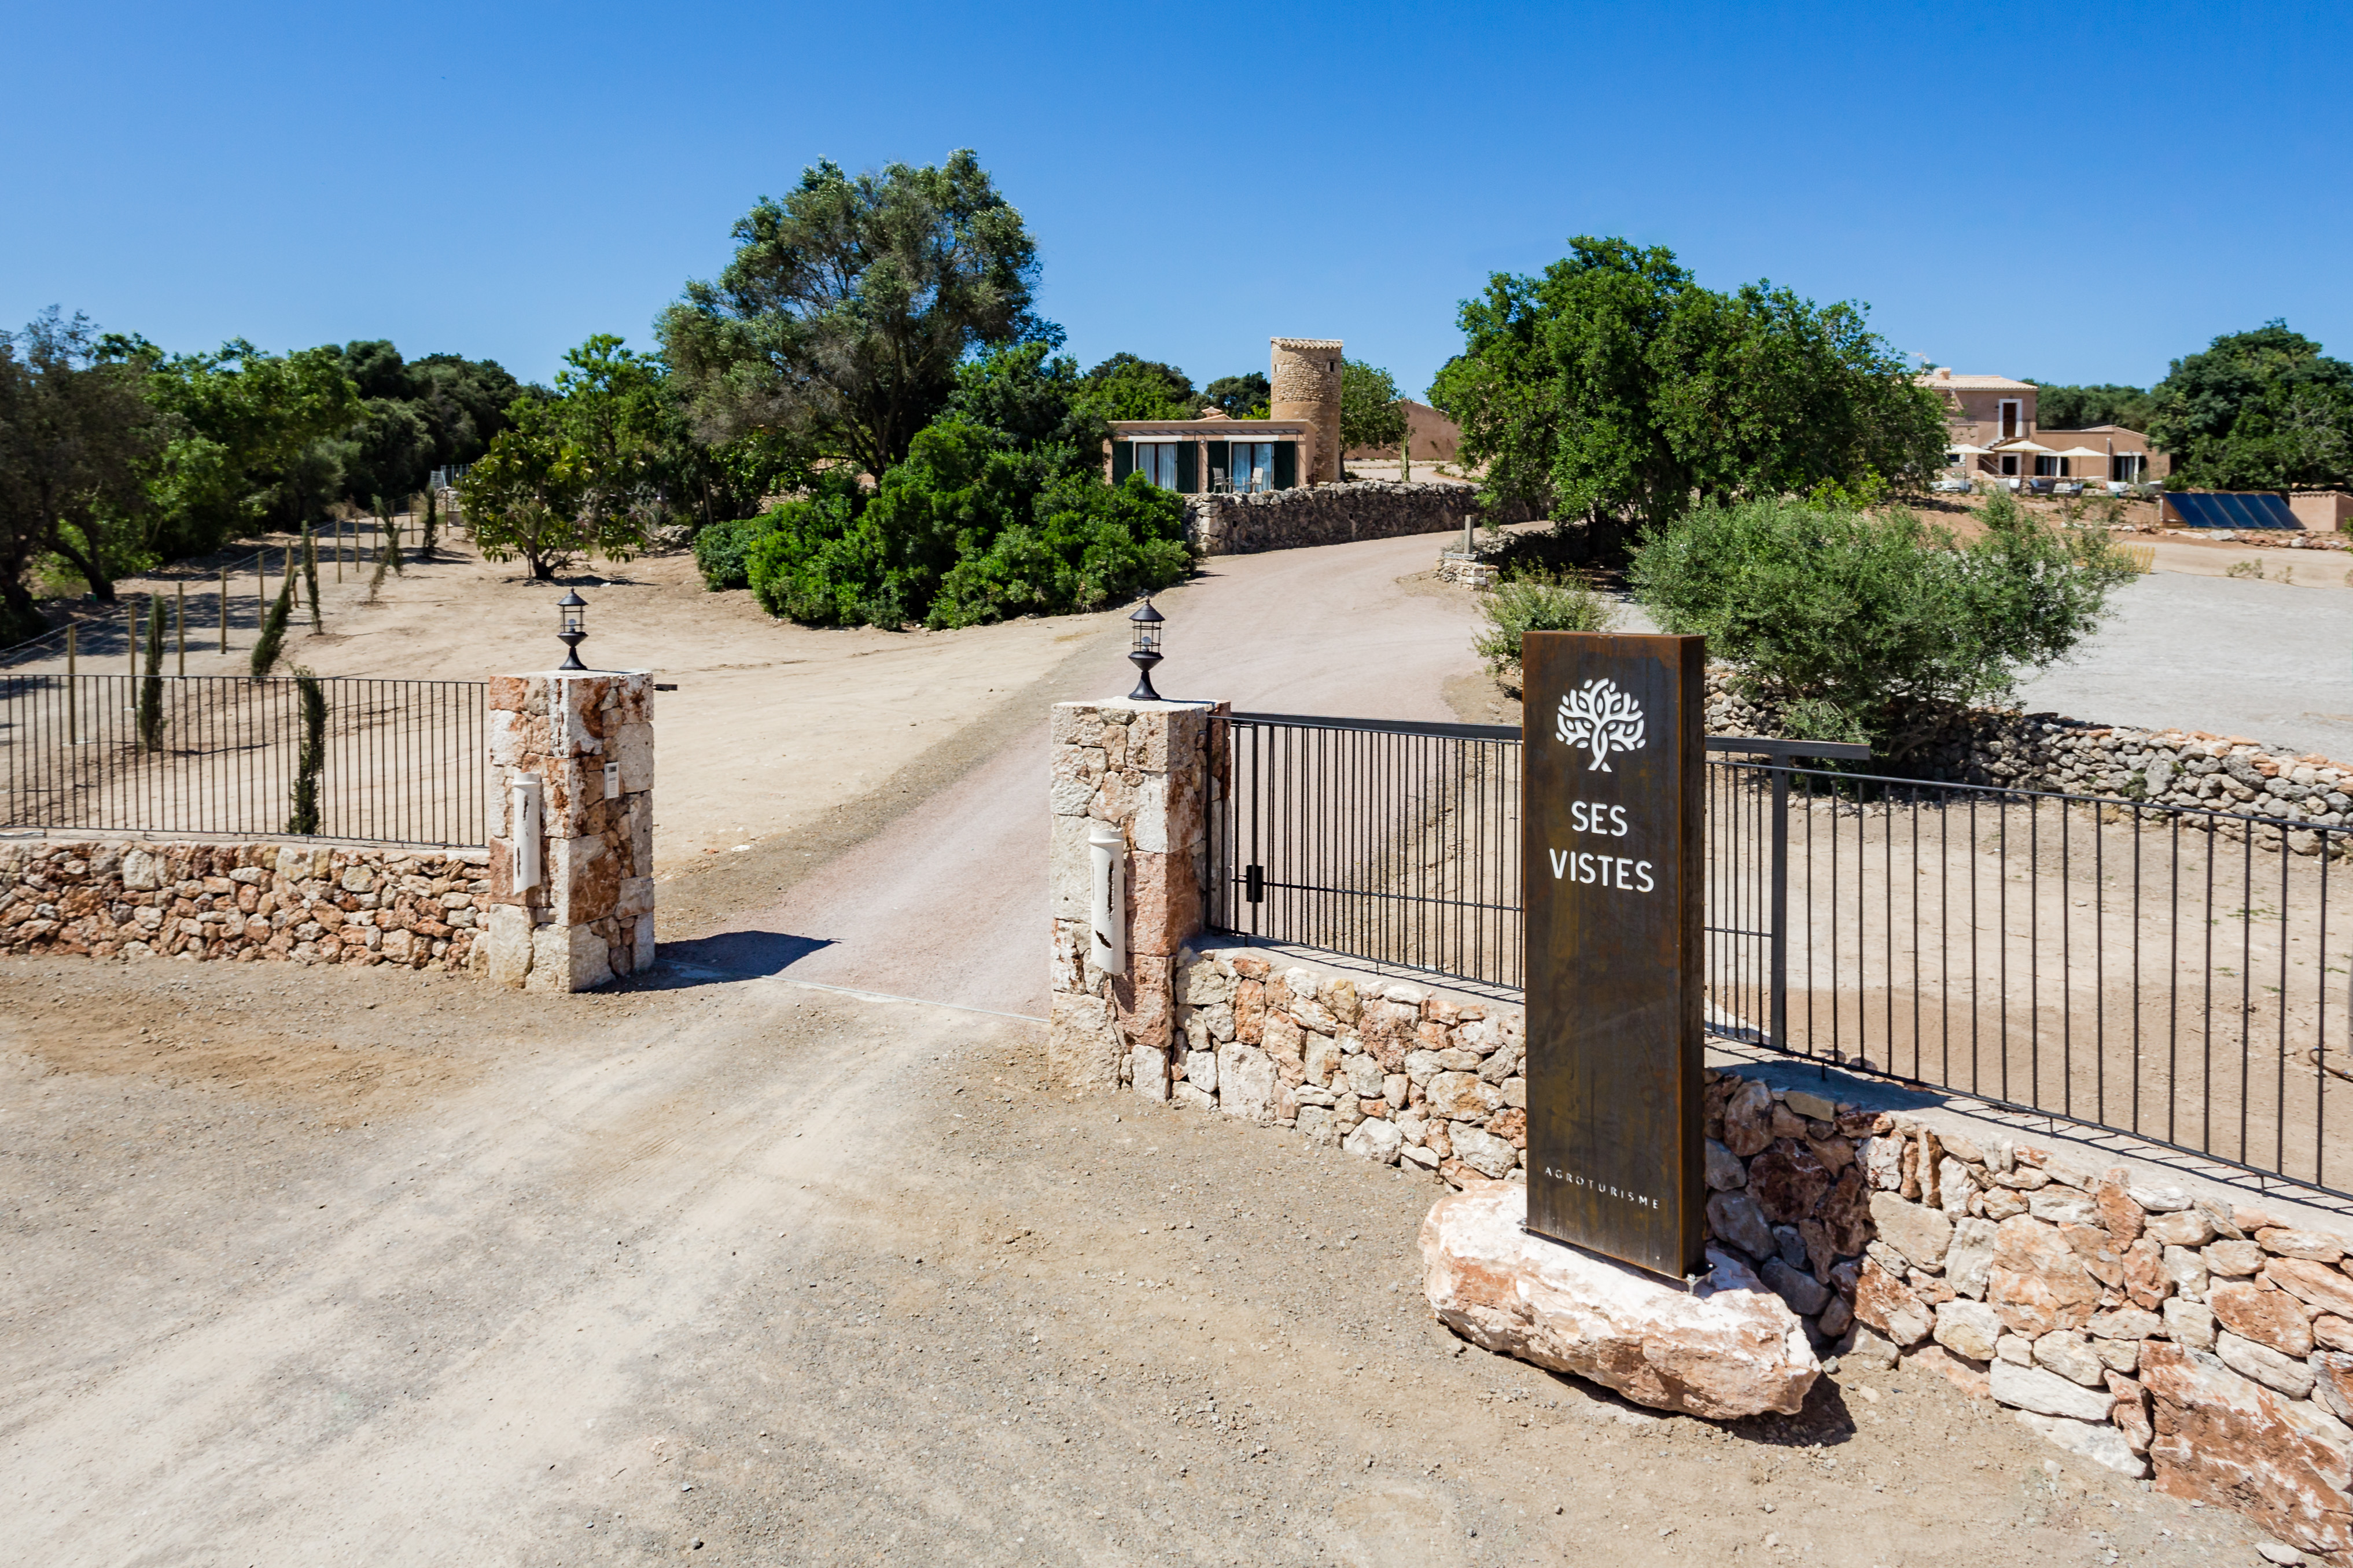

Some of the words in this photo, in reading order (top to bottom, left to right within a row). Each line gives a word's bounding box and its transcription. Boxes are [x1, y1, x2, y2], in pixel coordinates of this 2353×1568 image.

[1571, 800, 1629, 837] SES
[1549, 848, 1655, 893] VISTES
[1544, 1166, 1659, 1210] AGROTURISME
